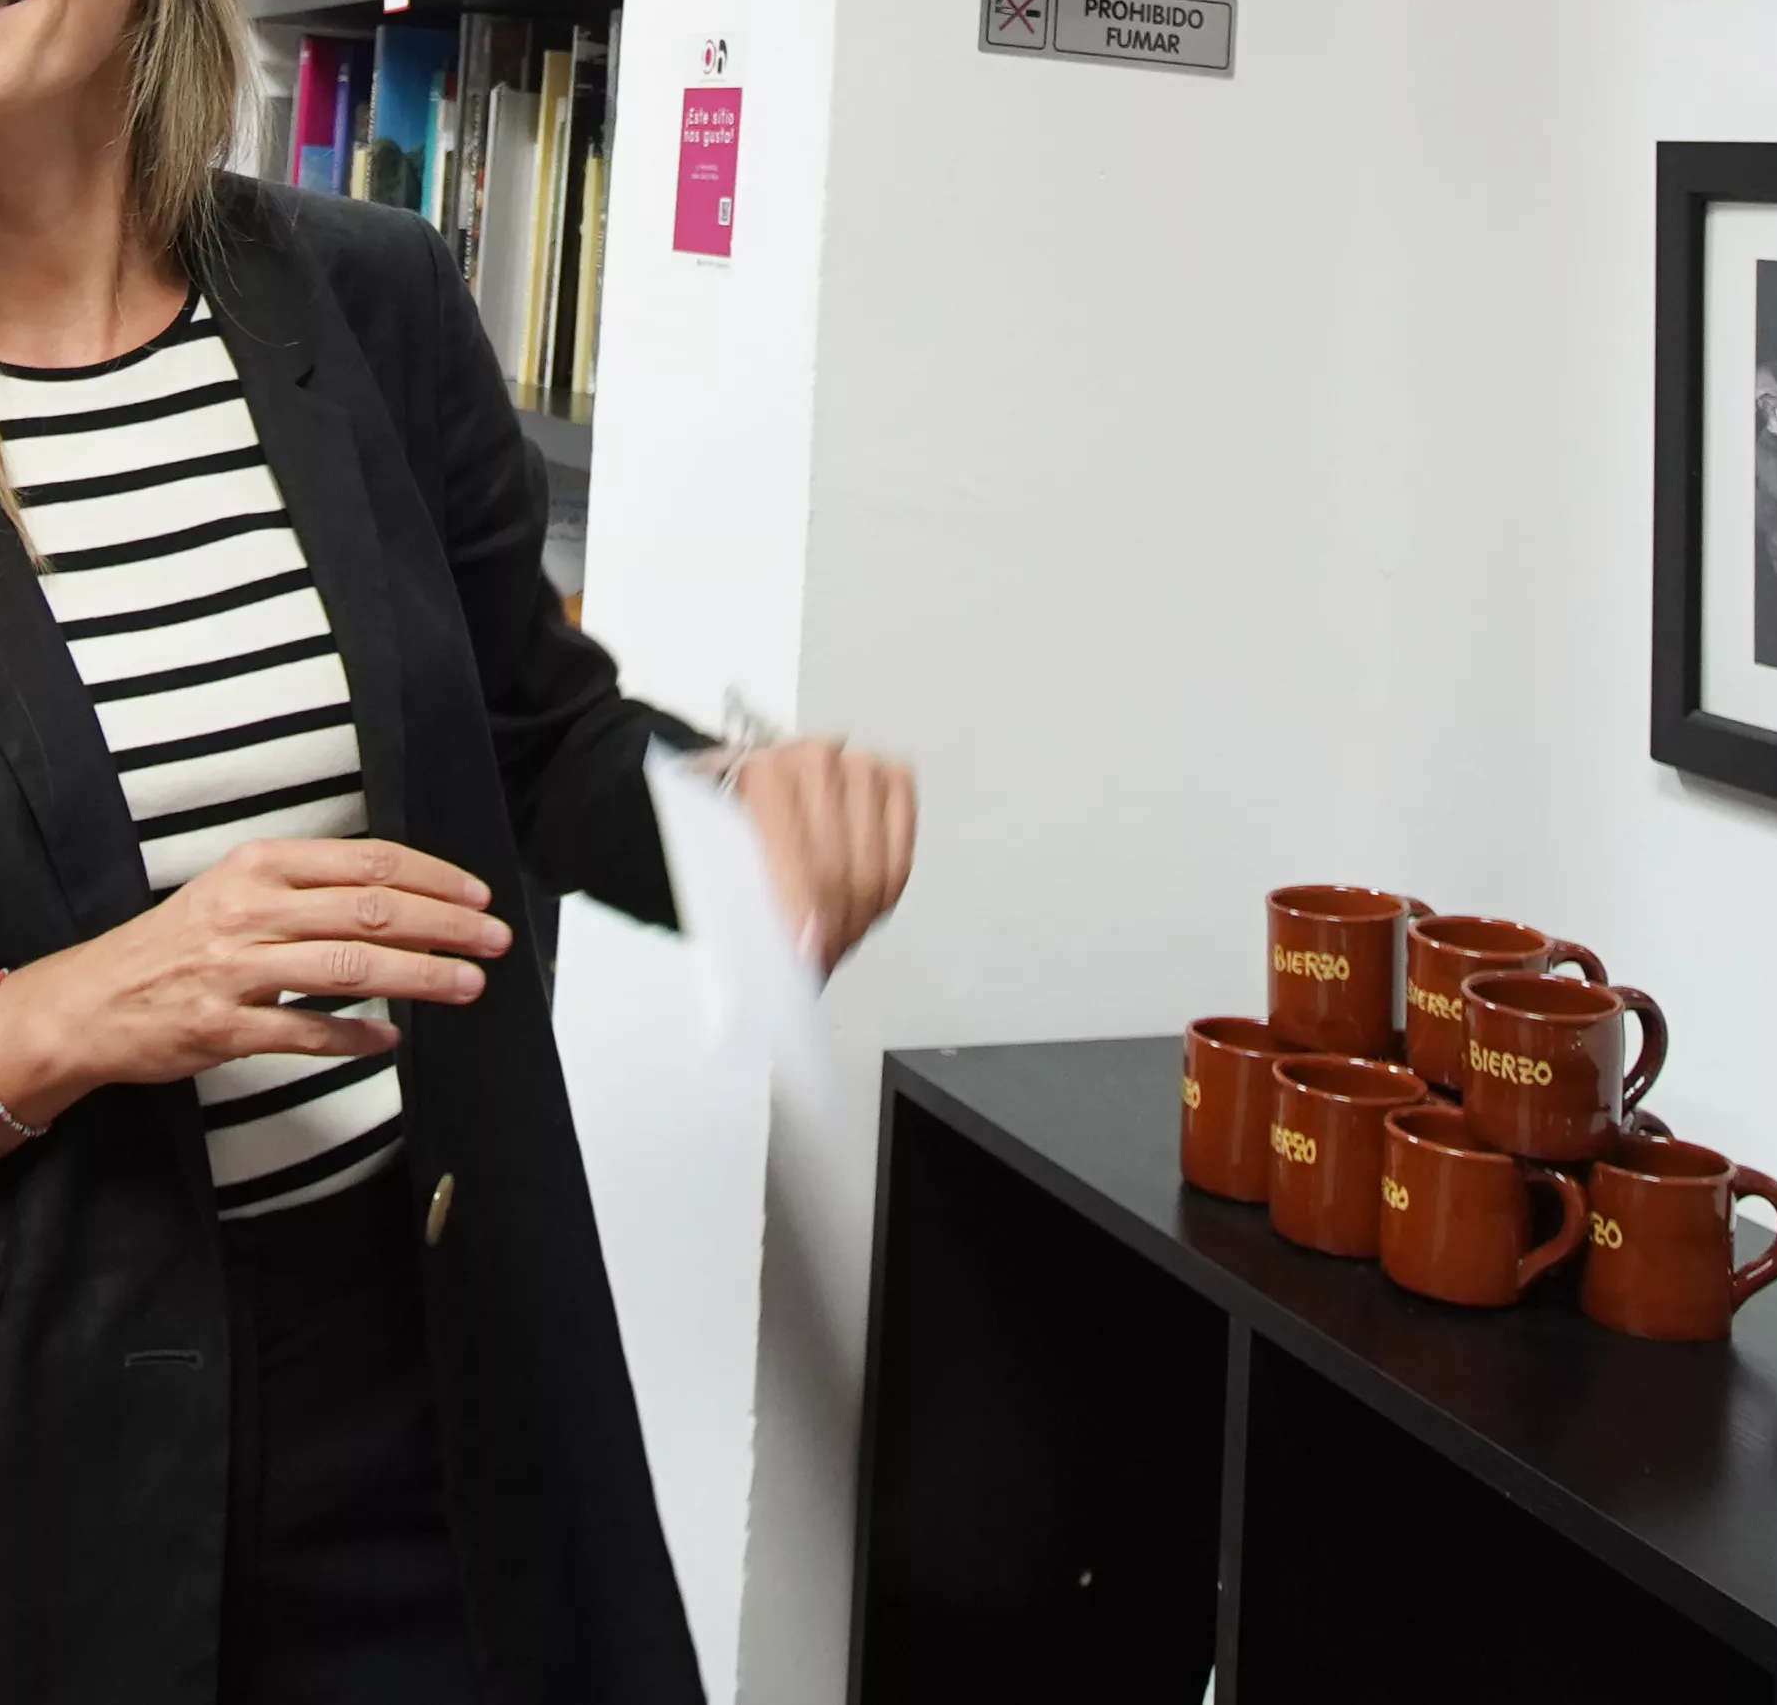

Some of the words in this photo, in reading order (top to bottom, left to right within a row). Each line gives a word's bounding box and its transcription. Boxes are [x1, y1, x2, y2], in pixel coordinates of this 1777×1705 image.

[1105, 27, 1181, 54] FUMAR
[713, 107, 735, 125] sitio
[684, 130, 700, 143] nos
[1272, 944, 1351, 982] BIERZO
[1469, 1038, 1554, 1087] BIERZO
